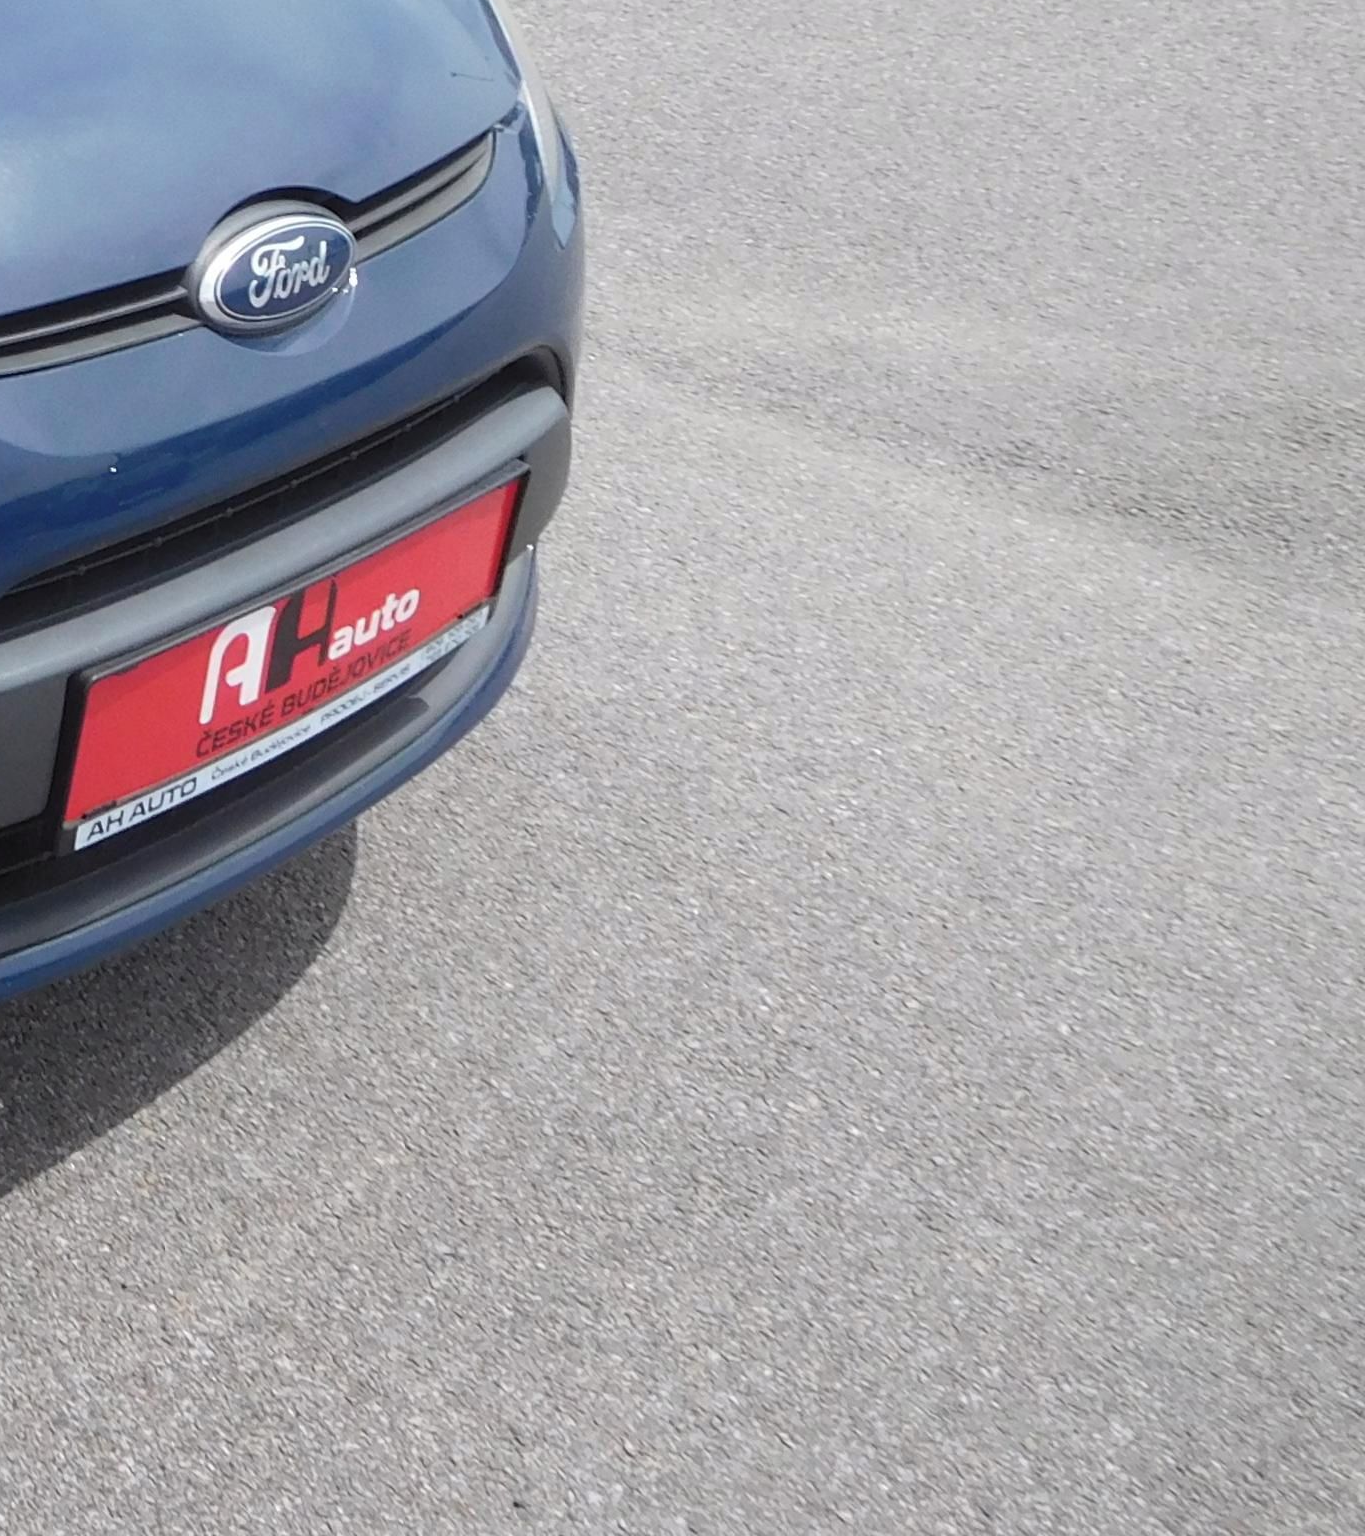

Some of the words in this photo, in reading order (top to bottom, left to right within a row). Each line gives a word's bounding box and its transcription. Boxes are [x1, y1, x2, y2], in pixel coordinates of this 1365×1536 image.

[249, 235, 331, 308] Ford
[195, 702, 276, 759] ČESKÉ
[281, 628, 413, 716] BUDĚJOVICE
[77, 810, 125, 841] AH
[128, 777, 198, 822] AUTO
